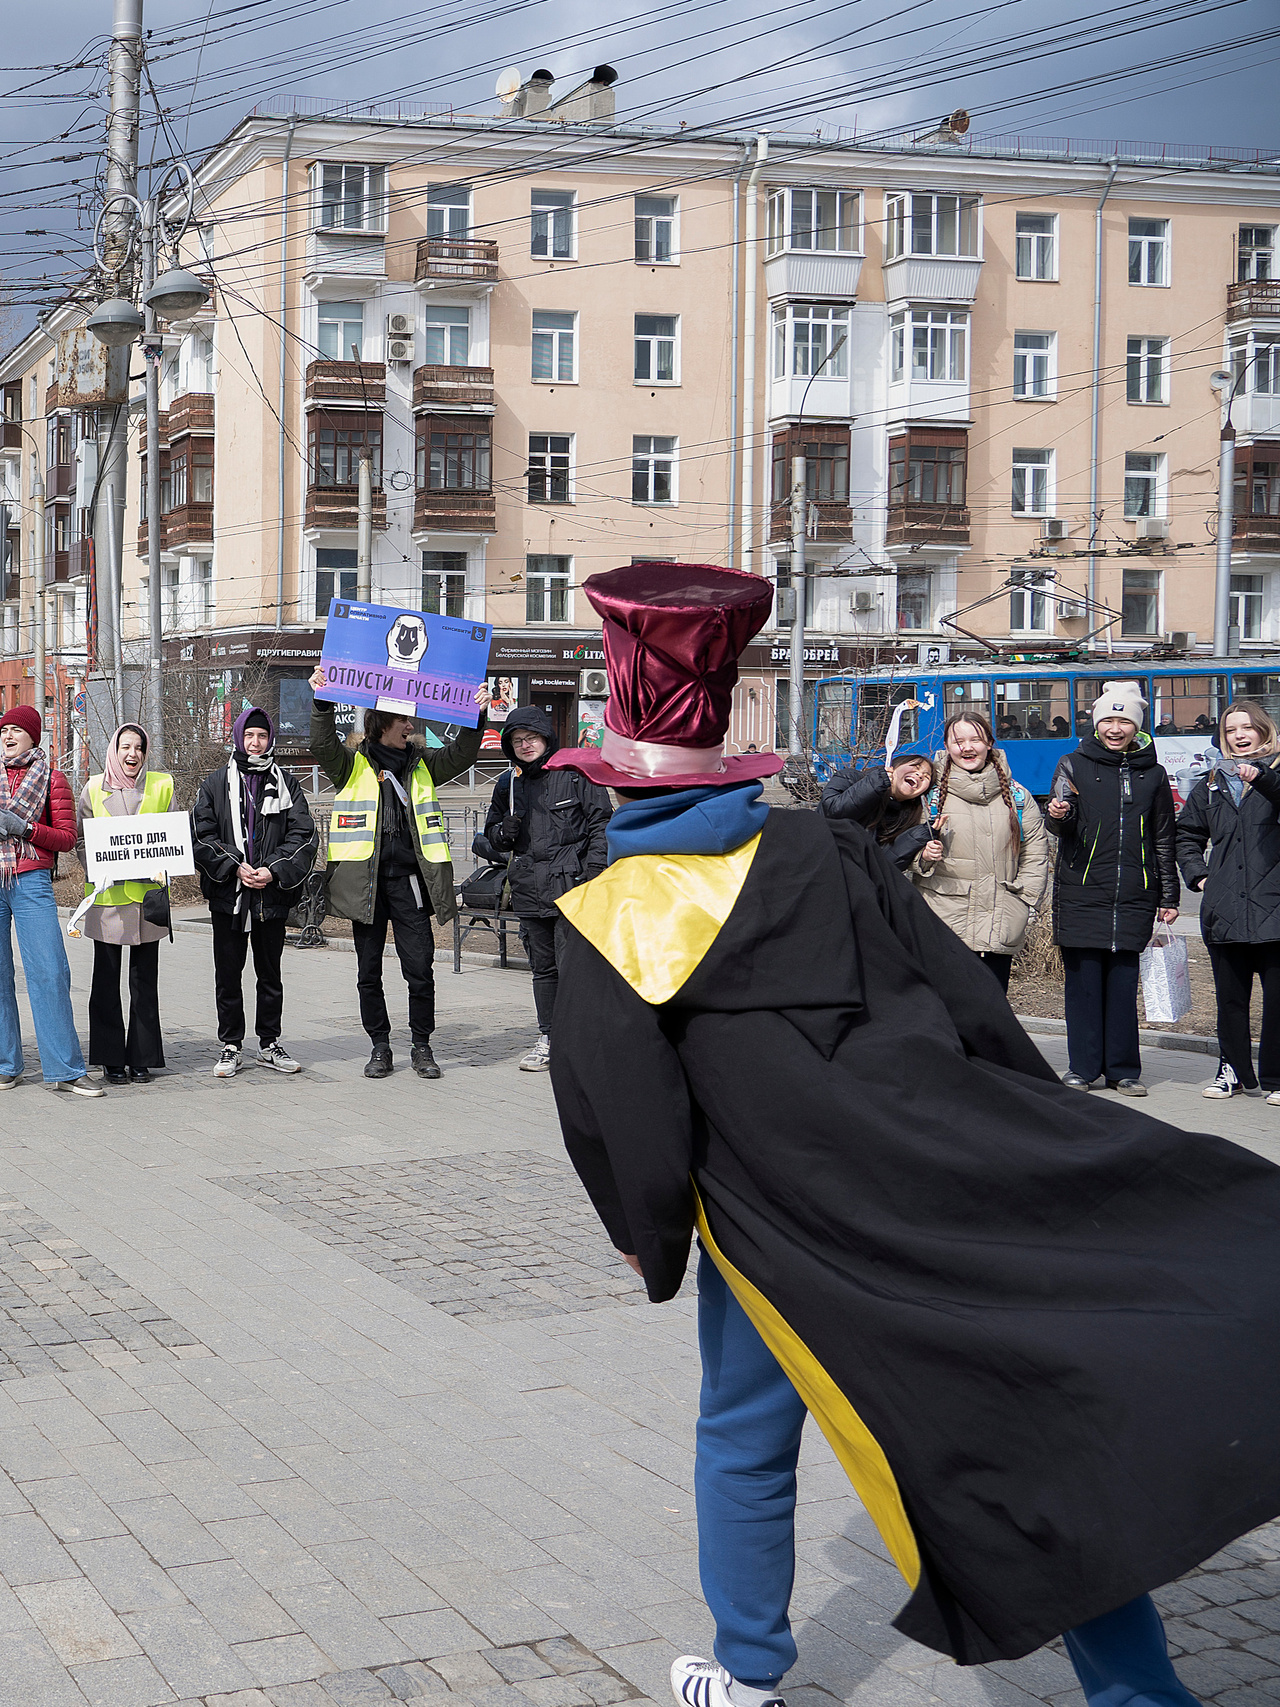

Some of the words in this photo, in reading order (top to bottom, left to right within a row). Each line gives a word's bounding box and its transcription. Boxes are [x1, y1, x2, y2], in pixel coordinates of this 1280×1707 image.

[771, 647, 839, 661] БРАОБРЕЙ
[328, 666, 393, 692] ОТПУСТИ
[406, 679, 472, 707] ГУСЕЙ!!!
[110, 834, 143, 846] МЕСТО
[147, 832, 167, 844] ДЛЯ
[95, 848, 130, 862] ВАШЕЙ
[134, 845, 184, 859] РЕКЛАМЫ
